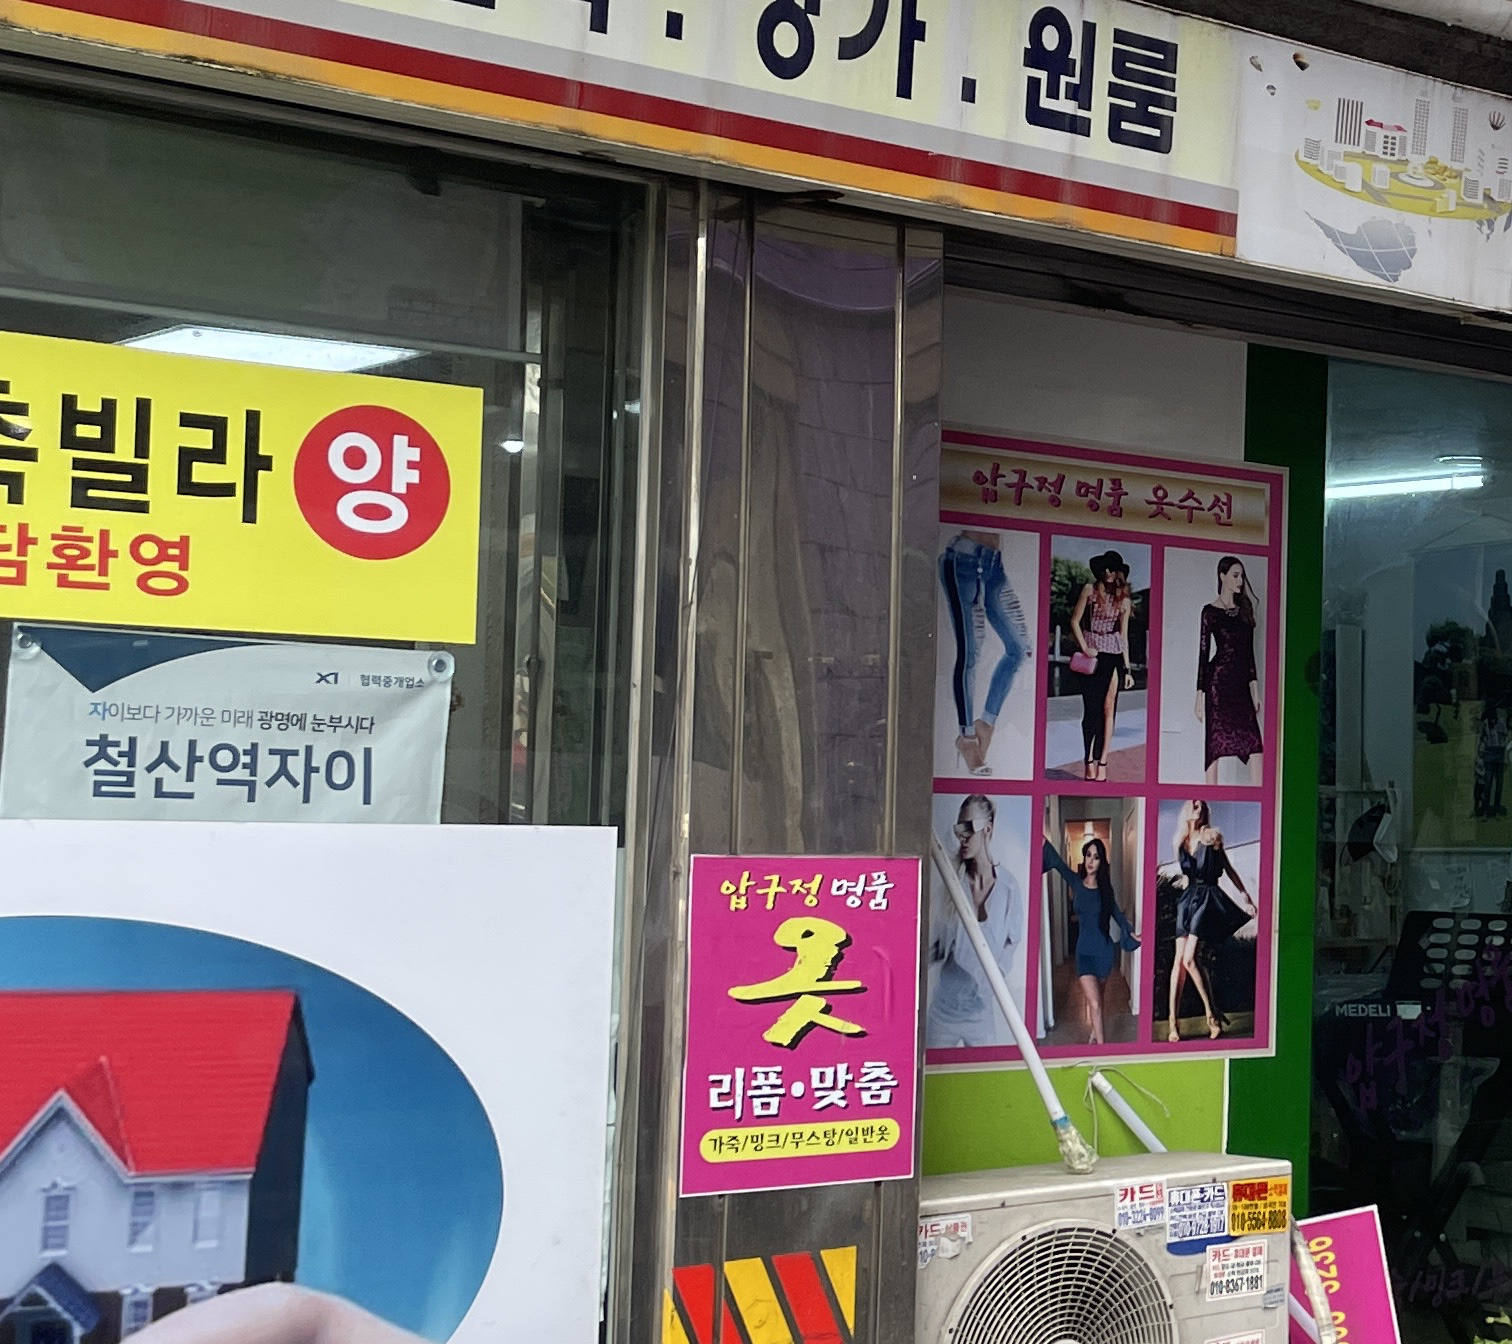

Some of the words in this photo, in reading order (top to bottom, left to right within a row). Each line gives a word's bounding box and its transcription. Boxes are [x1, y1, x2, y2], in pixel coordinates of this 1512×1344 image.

[1023, 5, 1179, 155] 원룸
[328, 431, 422, 534] 양
[971, 462, 1066, 509] 압구정
[1075, 478, 1129, 518] 명품
[1144, 483, 1233, 527] 옷수선
[359, 673, 426, 689] 협력중개업소
[89, 701, 160, 723] 자이보다
[165, 705, 217, 727] 가까운
[220, 707, 253, 729] 미래
[257, 710, 307, 732] 광명에
[310, 714, 375, 735] 눈부시다
[82, 733, 373, 805] 철산역자이
[720, 870, 825, 912] 압구정
[830, 870, 896, 912] 명품
[727, 916, 872, 1050] 옷
[1118, 1184, 1155, 1204] 카드
[1211, 1248, 1231, 1263] 카드
